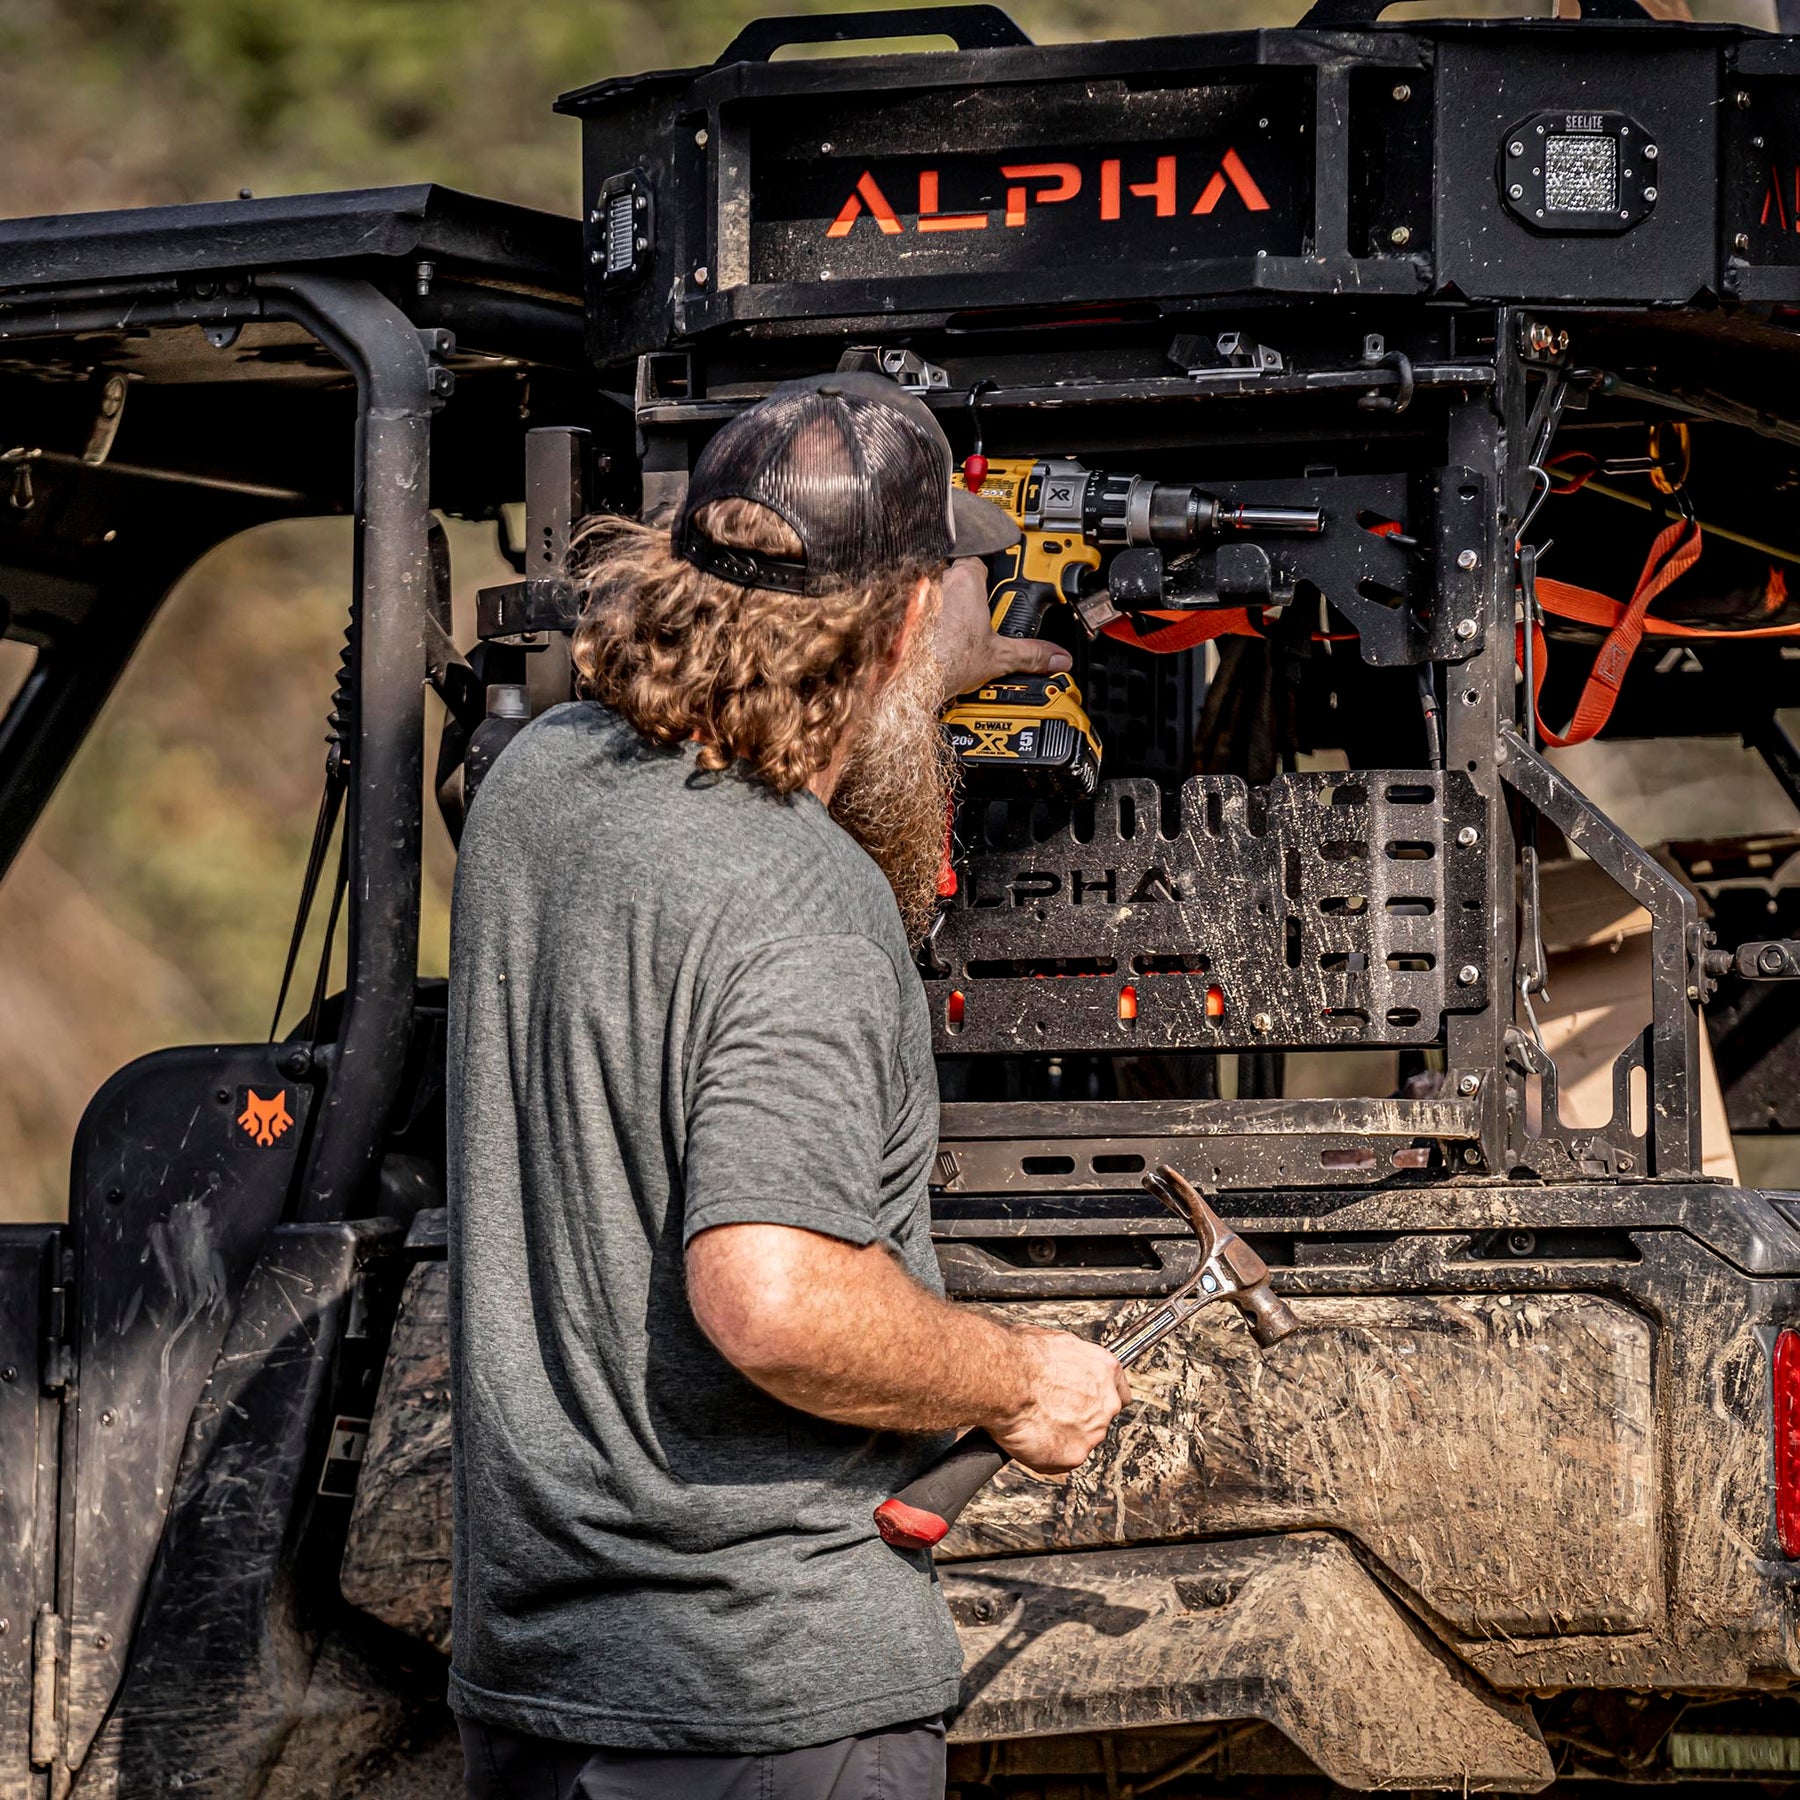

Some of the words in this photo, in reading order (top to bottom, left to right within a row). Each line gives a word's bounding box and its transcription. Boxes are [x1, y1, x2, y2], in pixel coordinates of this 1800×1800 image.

[1565, 115, 1603, 131] SEELITE
[825, 147, 1271, 238] ALPHA
[1049, 487, 1070, 501] XR
[974, 732, 1009, 752] XR
[1019, 731, 1033, 747] 5
[963, 866, 1181, 909] LPHA
